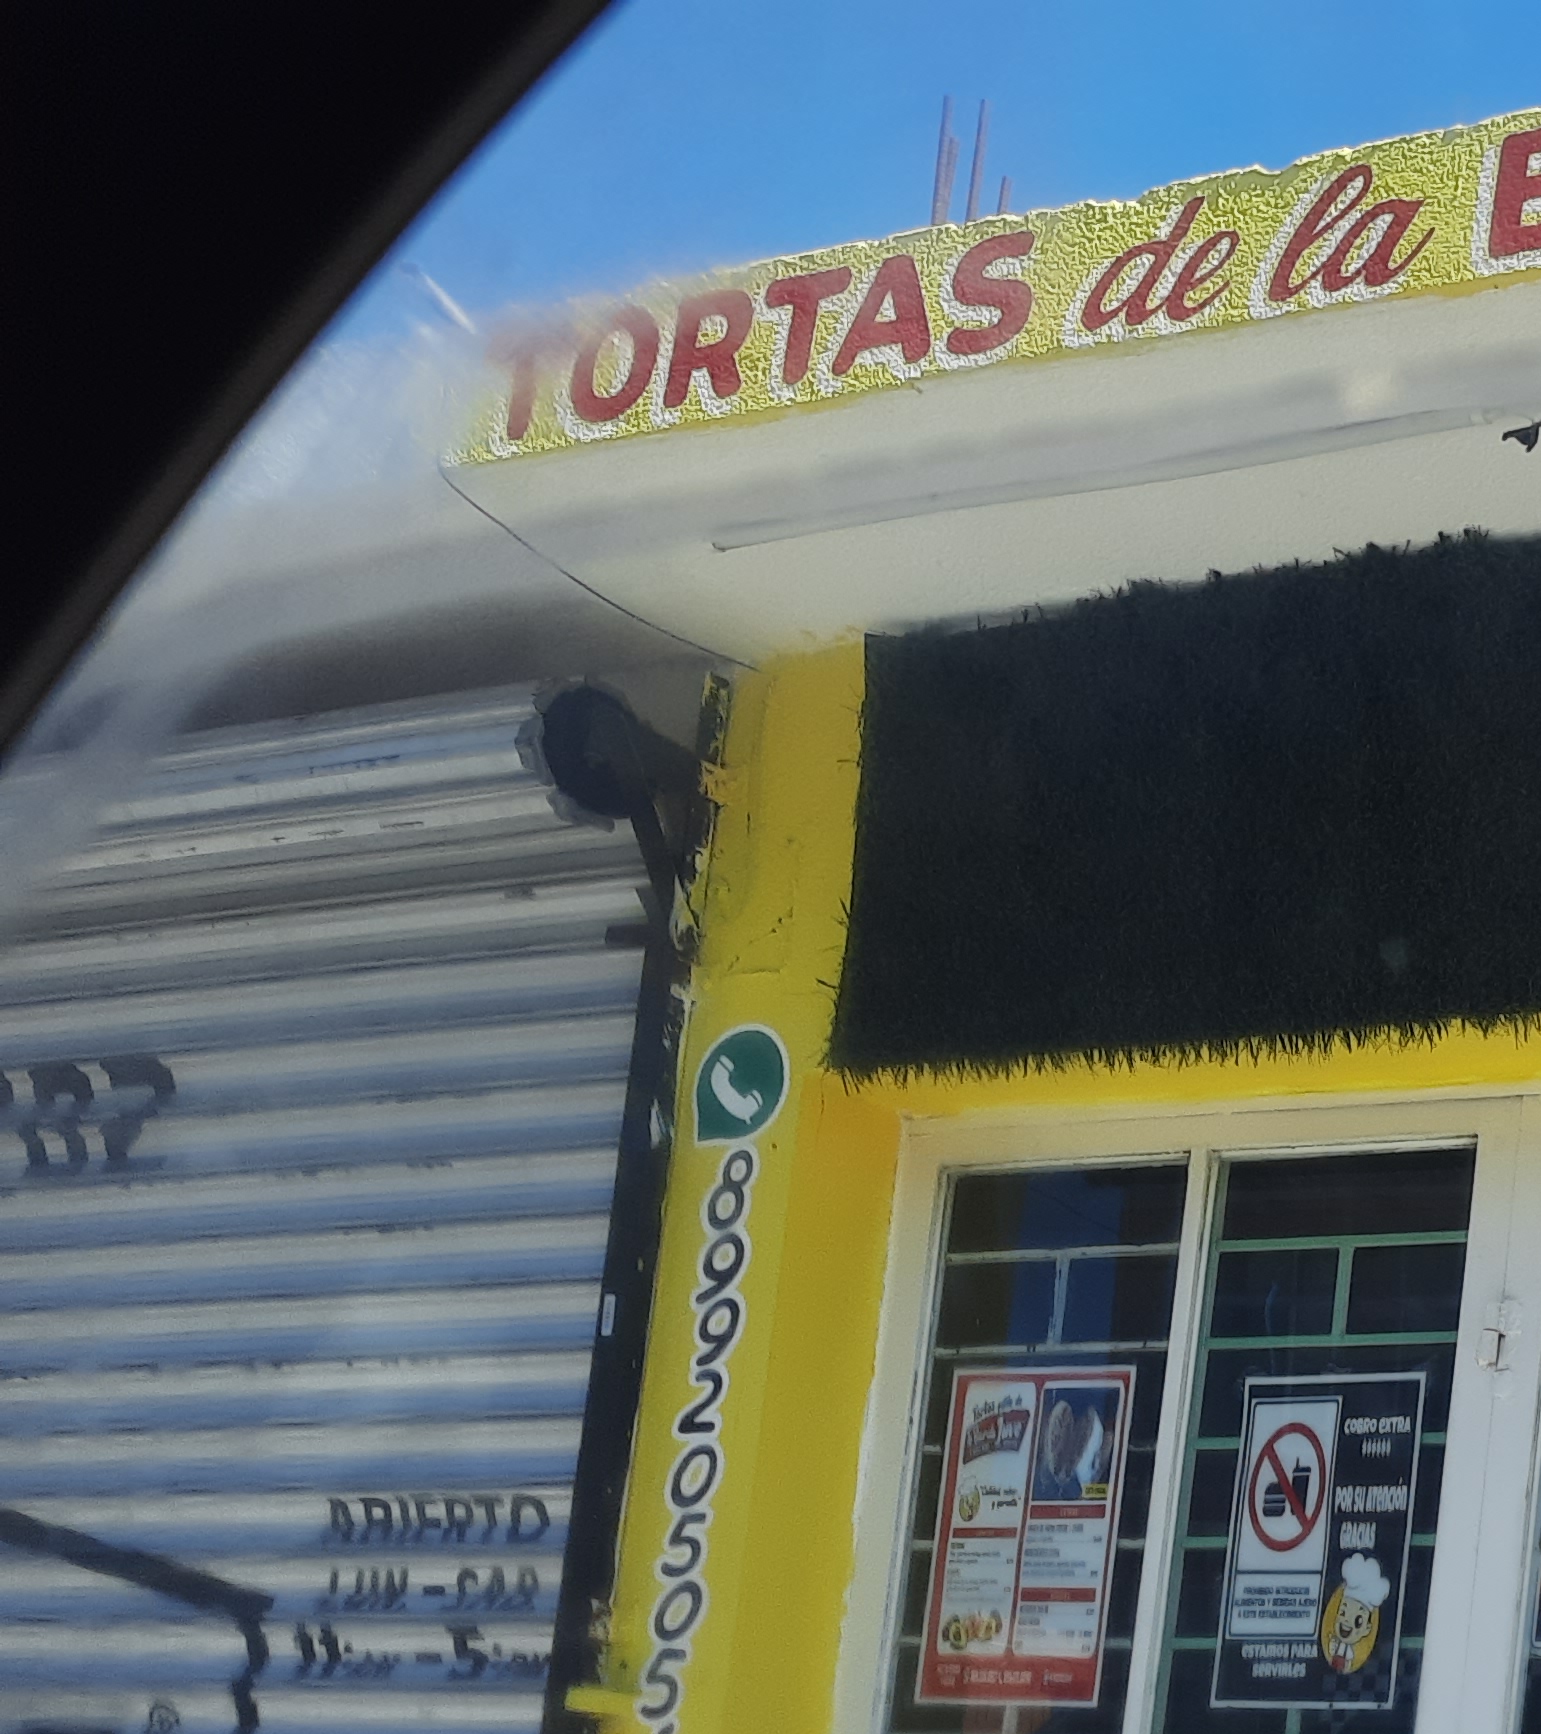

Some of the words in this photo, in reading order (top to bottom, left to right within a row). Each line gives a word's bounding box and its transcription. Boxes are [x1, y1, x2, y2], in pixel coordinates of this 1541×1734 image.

[490, 230, 1034, 440] TORTAS
[1082, 196, 1239, 332] de
[1268, 164, 1434, 302] la
